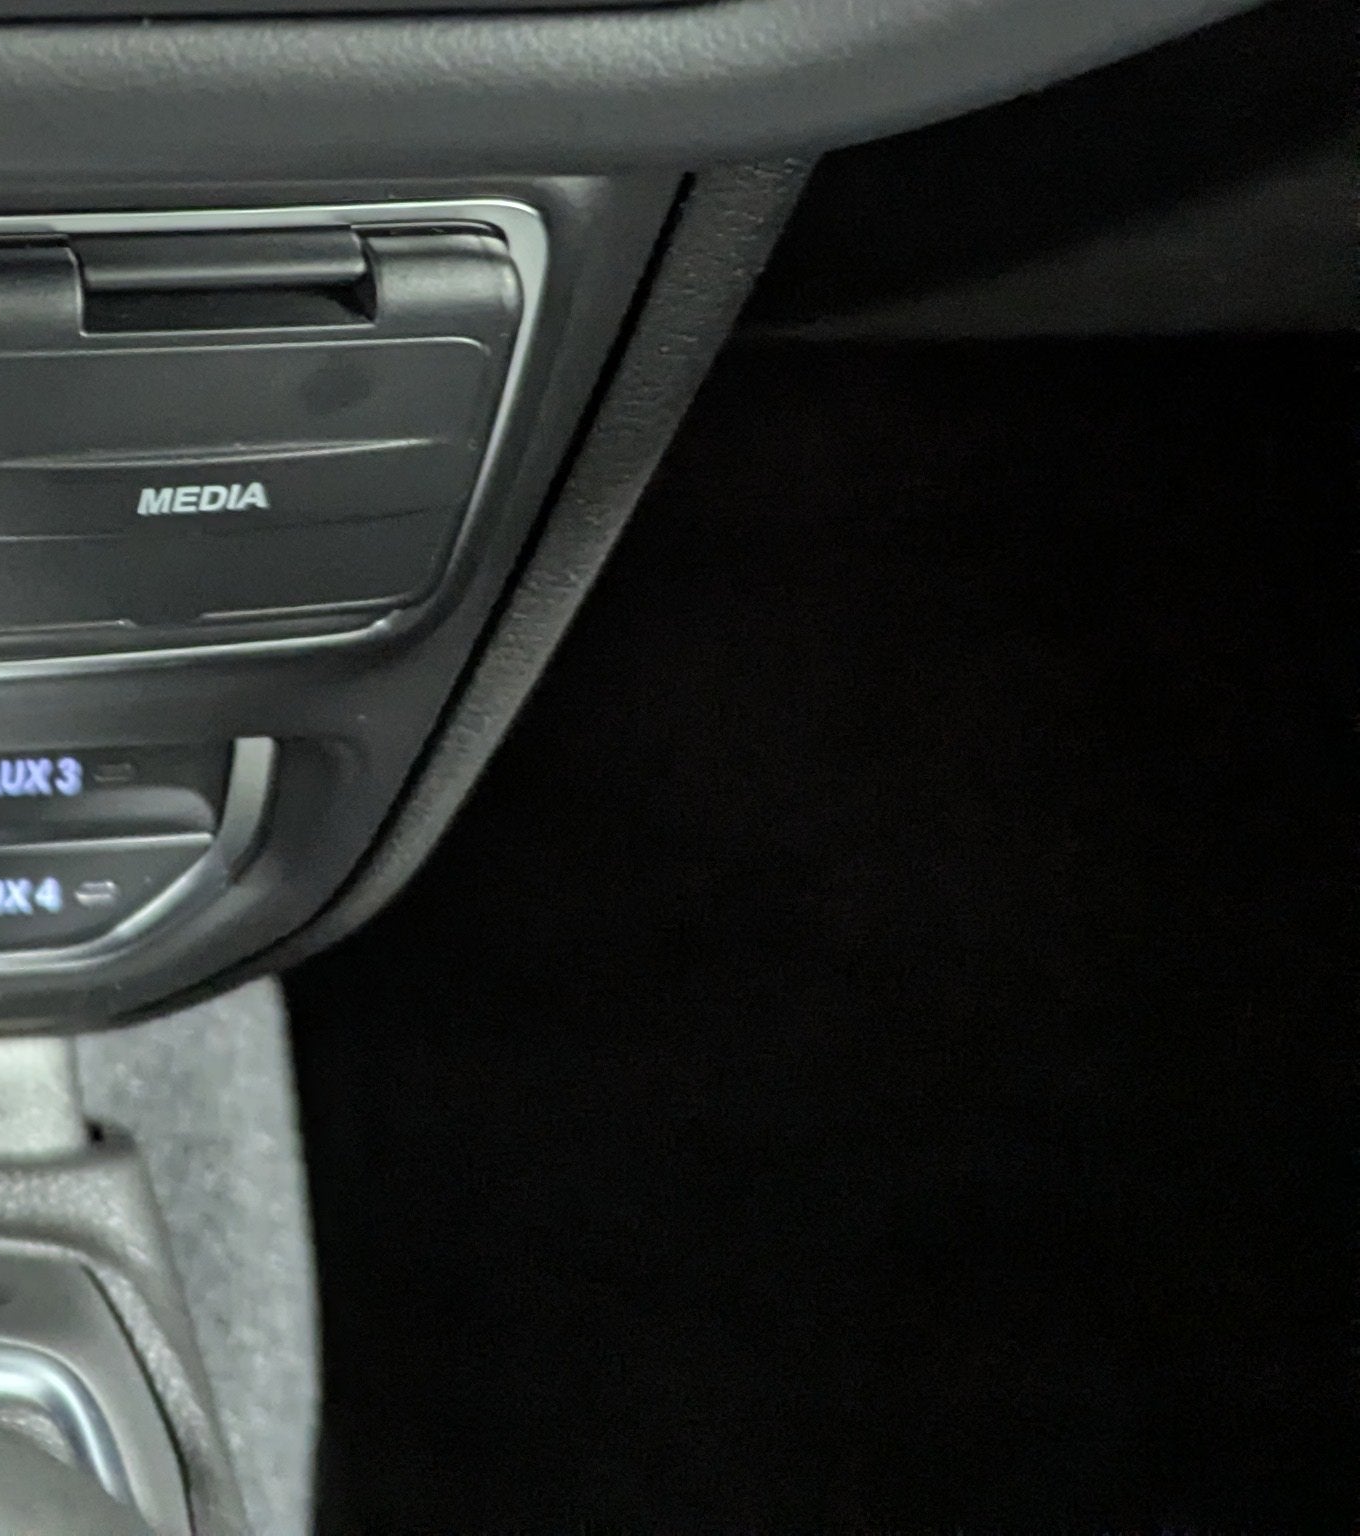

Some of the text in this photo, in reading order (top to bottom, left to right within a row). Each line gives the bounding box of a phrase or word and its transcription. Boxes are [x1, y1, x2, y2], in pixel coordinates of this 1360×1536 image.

[136, 481, 269, 516] MEDIA
[54, 756, 83, 796] 3
[34, 876, 63, 913] 4
